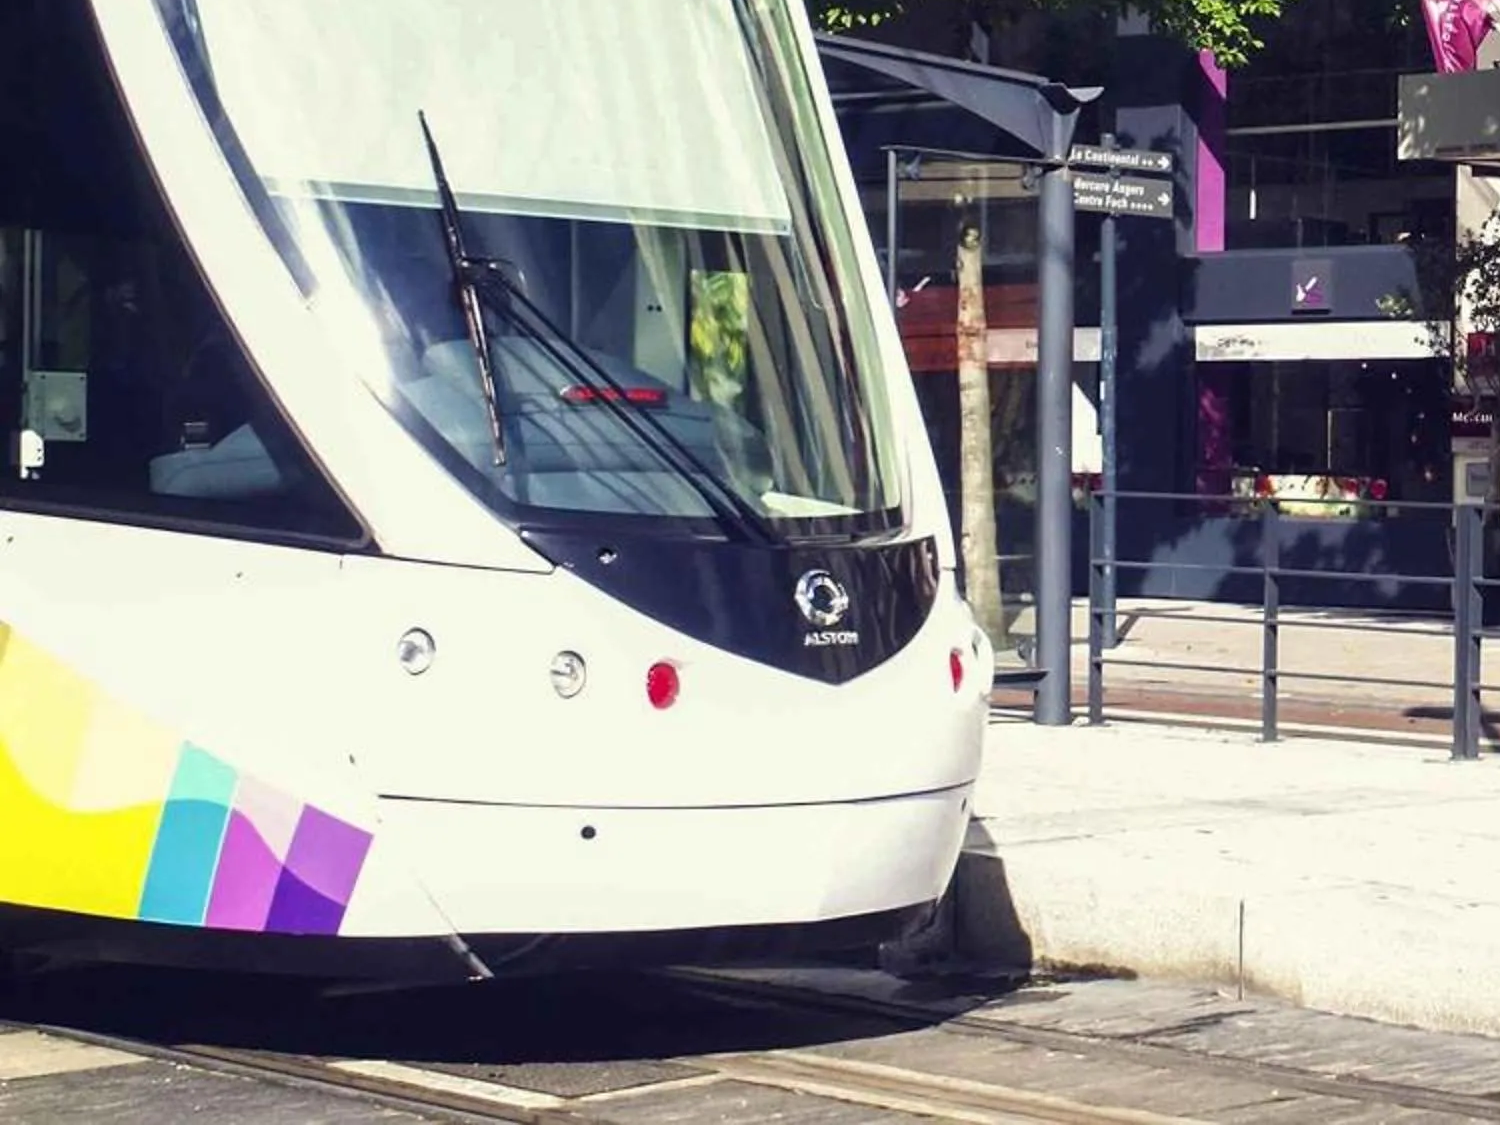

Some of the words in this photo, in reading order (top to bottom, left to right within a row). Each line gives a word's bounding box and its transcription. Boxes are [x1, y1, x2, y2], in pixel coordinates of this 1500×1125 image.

[1085, 148, 1140, 166] Continental
[1073, 177, 1110, 193] Mercure
[1112, 179, 1145, 197] Angers
[1105, 194, 1128, 209] Foch
[804, 630, 859, 646] ALSTOM
